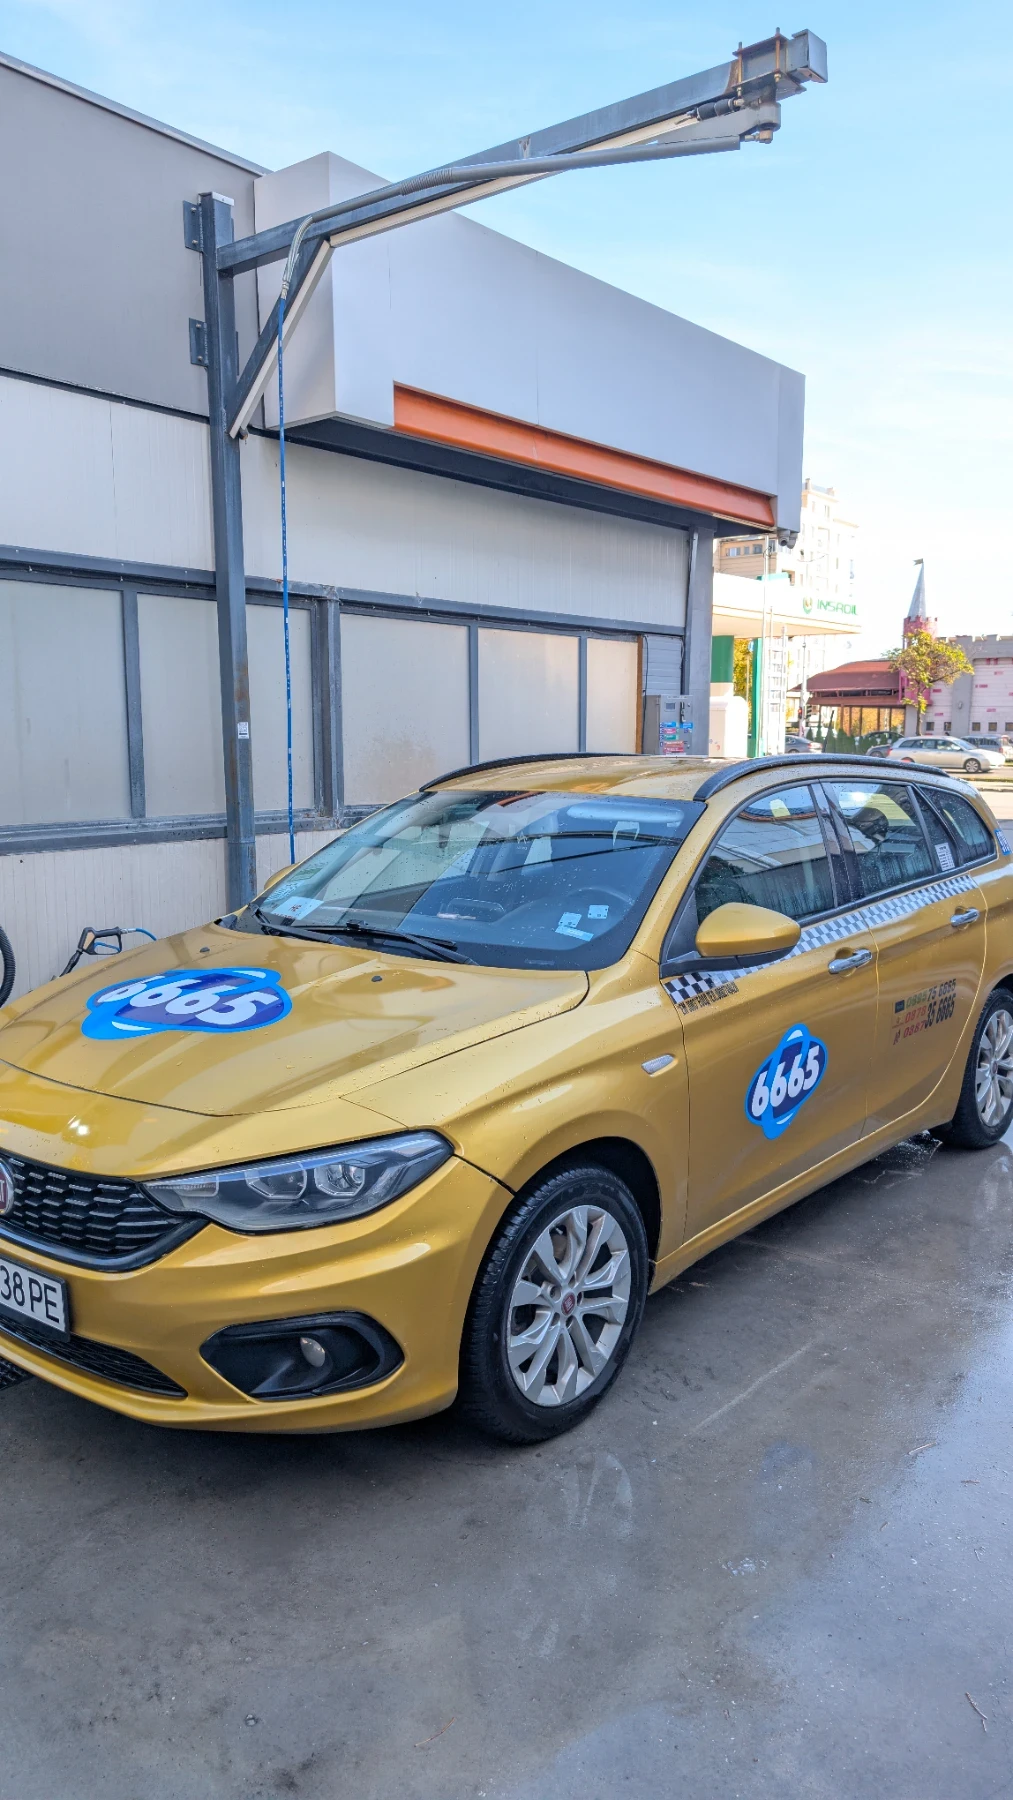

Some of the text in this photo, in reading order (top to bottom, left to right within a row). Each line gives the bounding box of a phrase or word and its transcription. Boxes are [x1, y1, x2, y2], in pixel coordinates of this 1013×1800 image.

[97, 975, 280, 1025] 6665
[751, 1045, 820, 1117] 6665
[28, 1277, 60, 1323] PE
